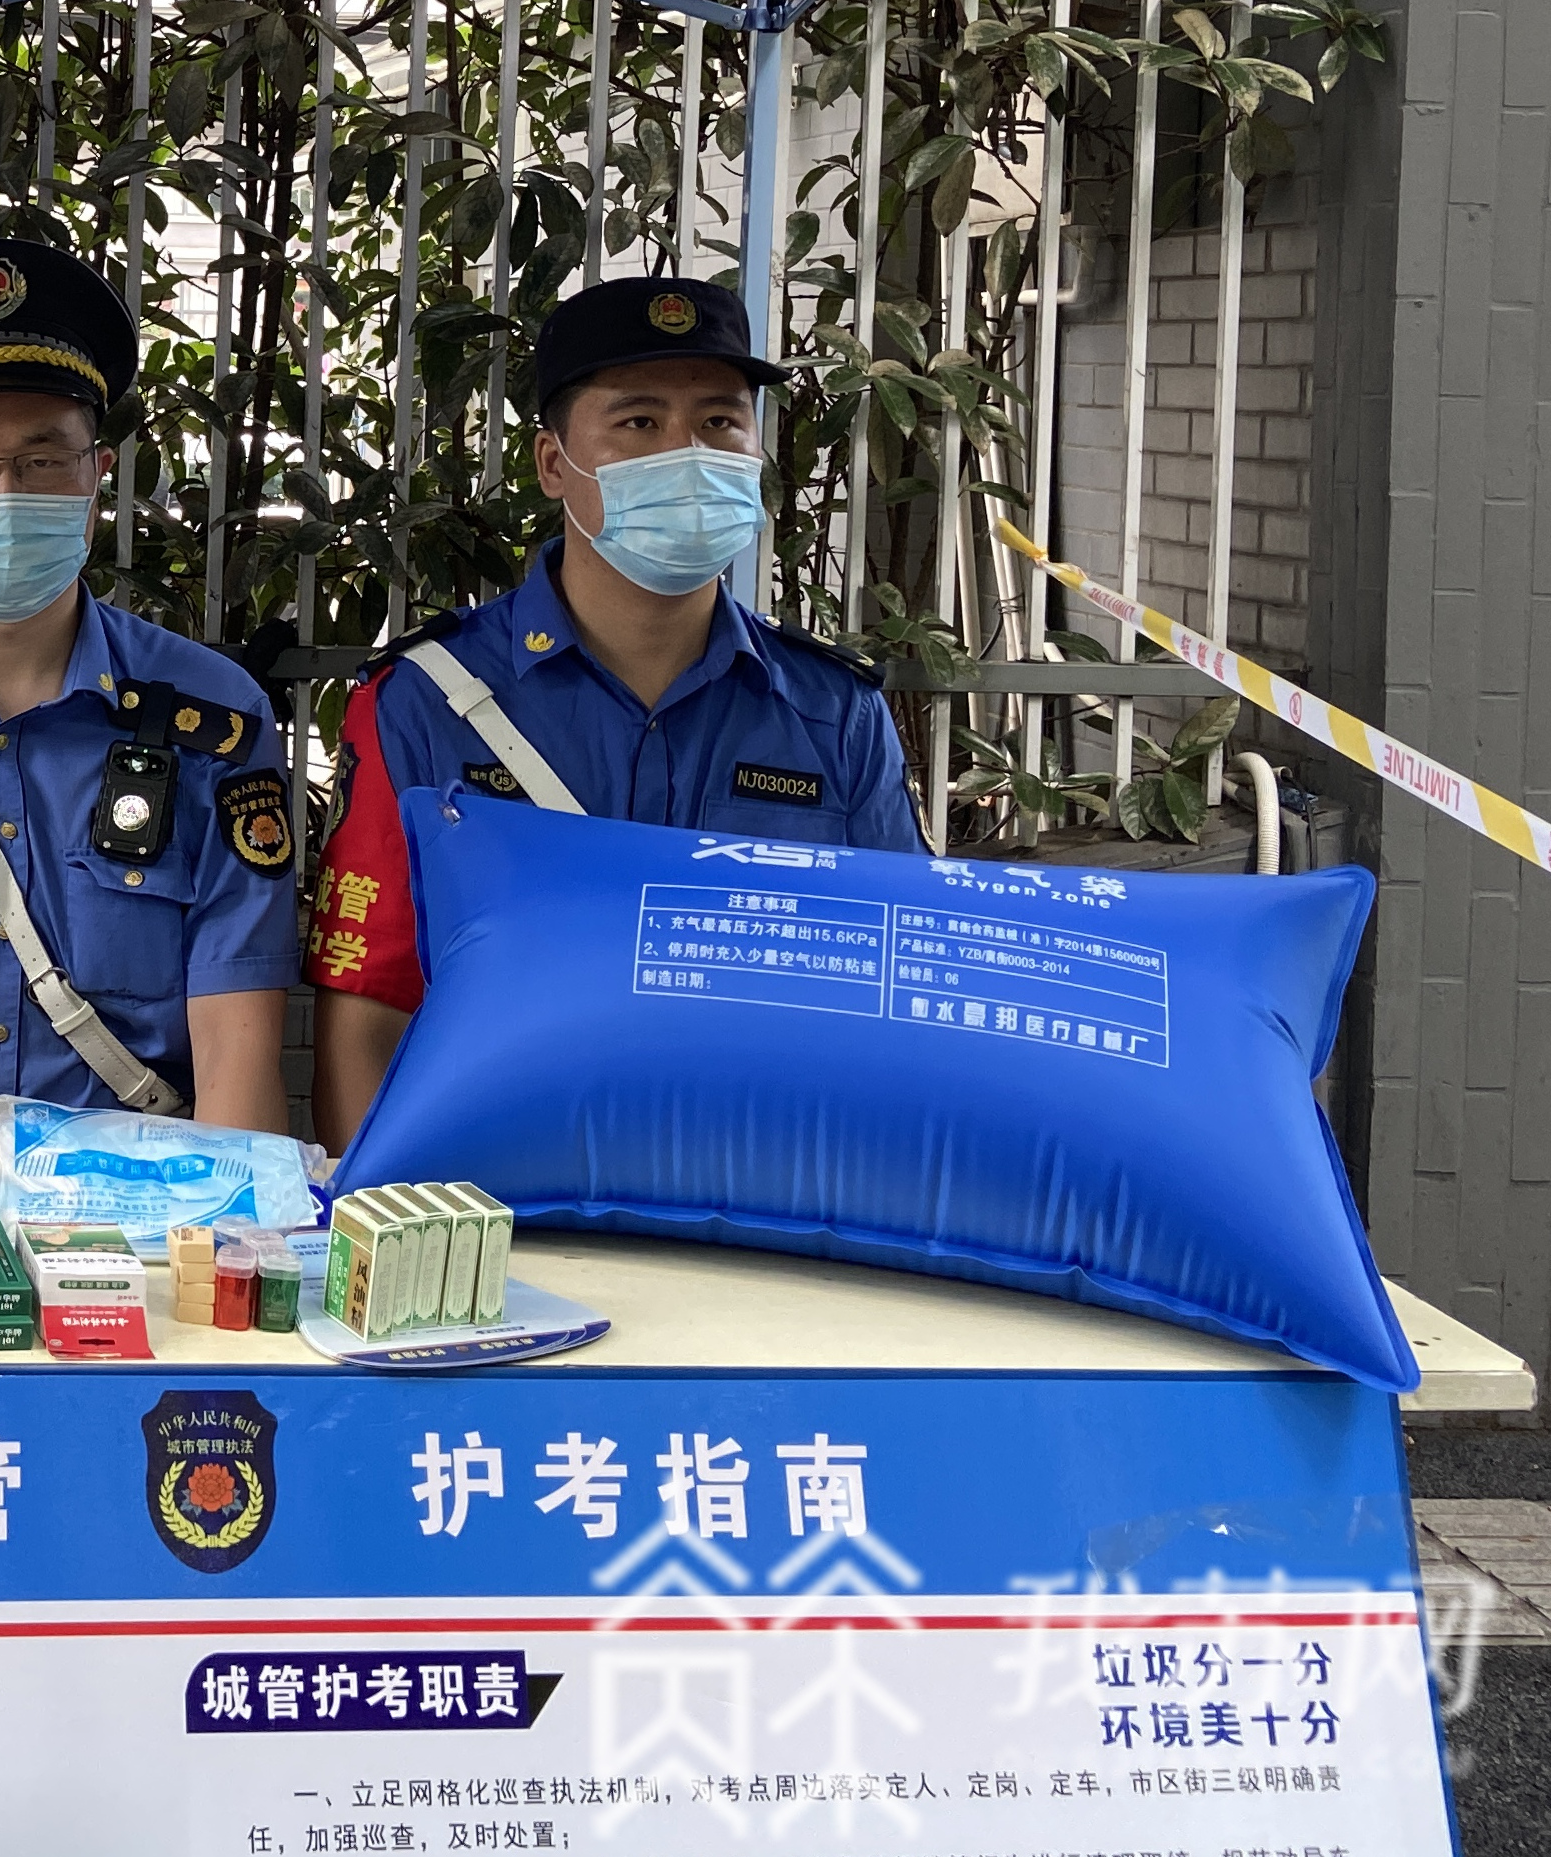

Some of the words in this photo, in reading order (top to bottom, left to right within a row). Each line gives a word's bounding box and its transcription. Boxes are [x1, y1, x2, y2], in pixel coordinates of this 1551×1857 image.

[736, 770, 817, 798] NJ030024
[1384, 743, 1461, 811] LIMITLNE
[728, 893, 799, 913] 注意事项
[945, 877, 1037, 897] oxygen
[1050, 890, 1111, 909] zone
[158, 1409, 261, 1438] 中华人民共和国
[166, 1437, 254, 1456] 城市管理执法
[410, 1432, 868, 1540] 护考指南
[1093, 1642, 1333, 1689] 垃圾分一分
[202, 1662, 520, 1720] 城管护考职责
[1100, 1701, 1340, 1749] 环境美十分
